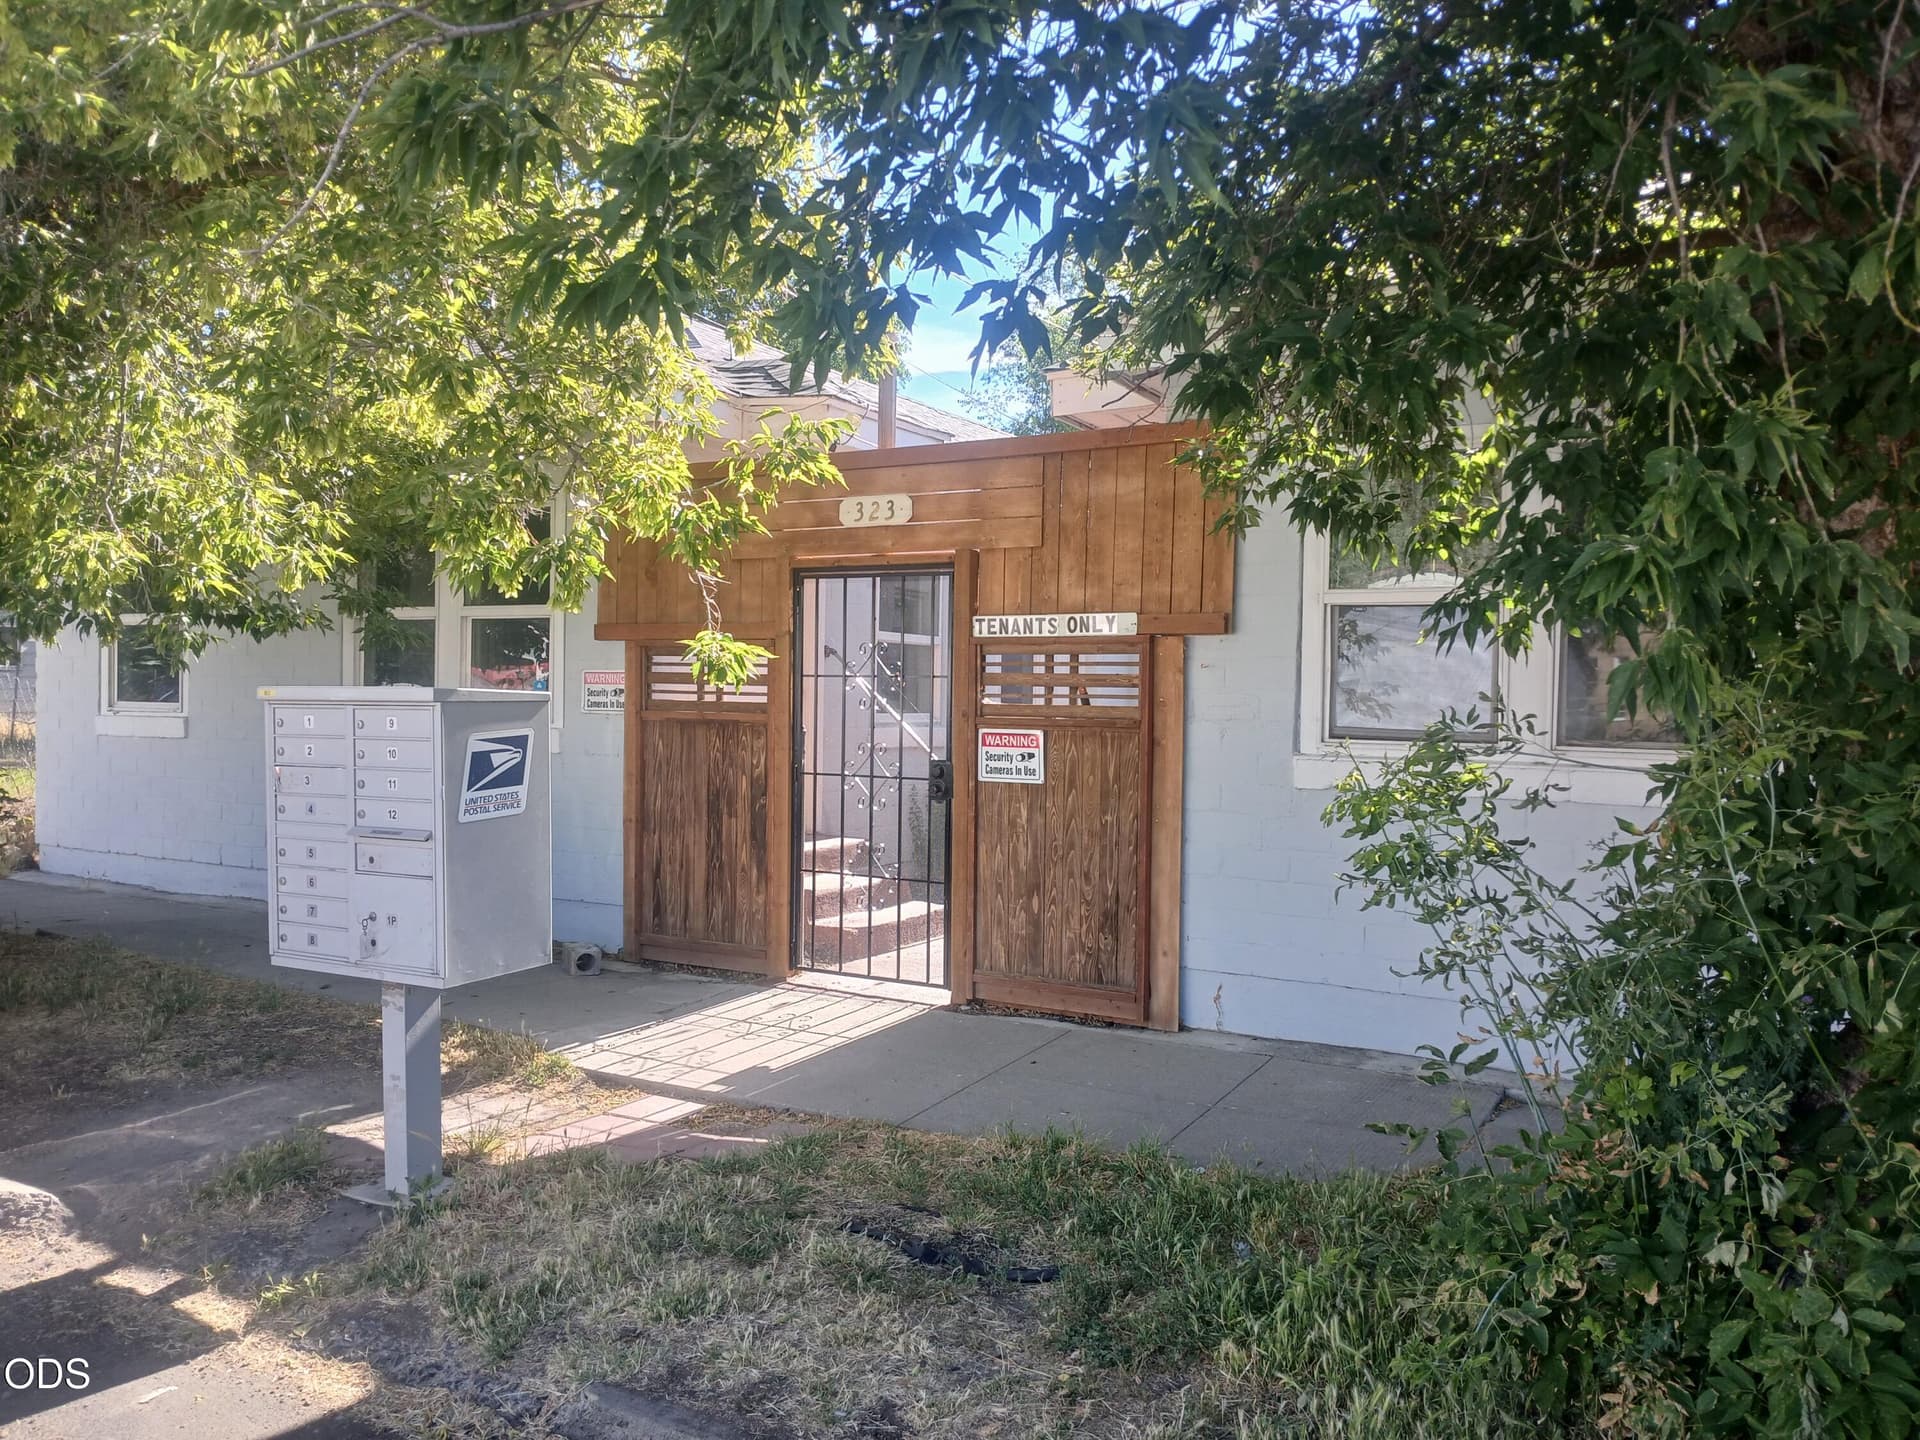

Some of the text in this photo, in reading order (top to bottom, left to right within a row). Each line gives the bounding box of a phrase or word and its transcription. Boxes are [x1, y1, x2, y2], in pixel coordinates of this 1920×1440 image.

[853, 499, 895, 522] 323
[975, 615, 1116, 635] TENANTS ONLY
[587, 687, 608, 699] Security
[587, 699, 608, 708] Cameras
[610, 699, 615, 708] In
[389, 718, 394, 728] 9
[984, 735, 1037, 747] WARNING
[307, 746, 313, 756] 2
[388, 749, 397, 759] 10
[985, 750, 1014, 764] Security
[985, 763, 1037, 777] Cameras In Use
[304, 775, 310, 785] 3
[388, 779, 397, 789] 11
[465, 791, 519, 806] UNITED STATES
[308, 804, 313, 814] 4
[463, 801, 521, 816] POSTAL SERVICE
[388, 809, 397, 820] 12
[308, 848, 314, 858] 5
[309, 878, 314, 887] 6
[310, 906, 315, 917] 7
[387, 916, 397, 926] 1P
[310, 935, 315, 945] 8
